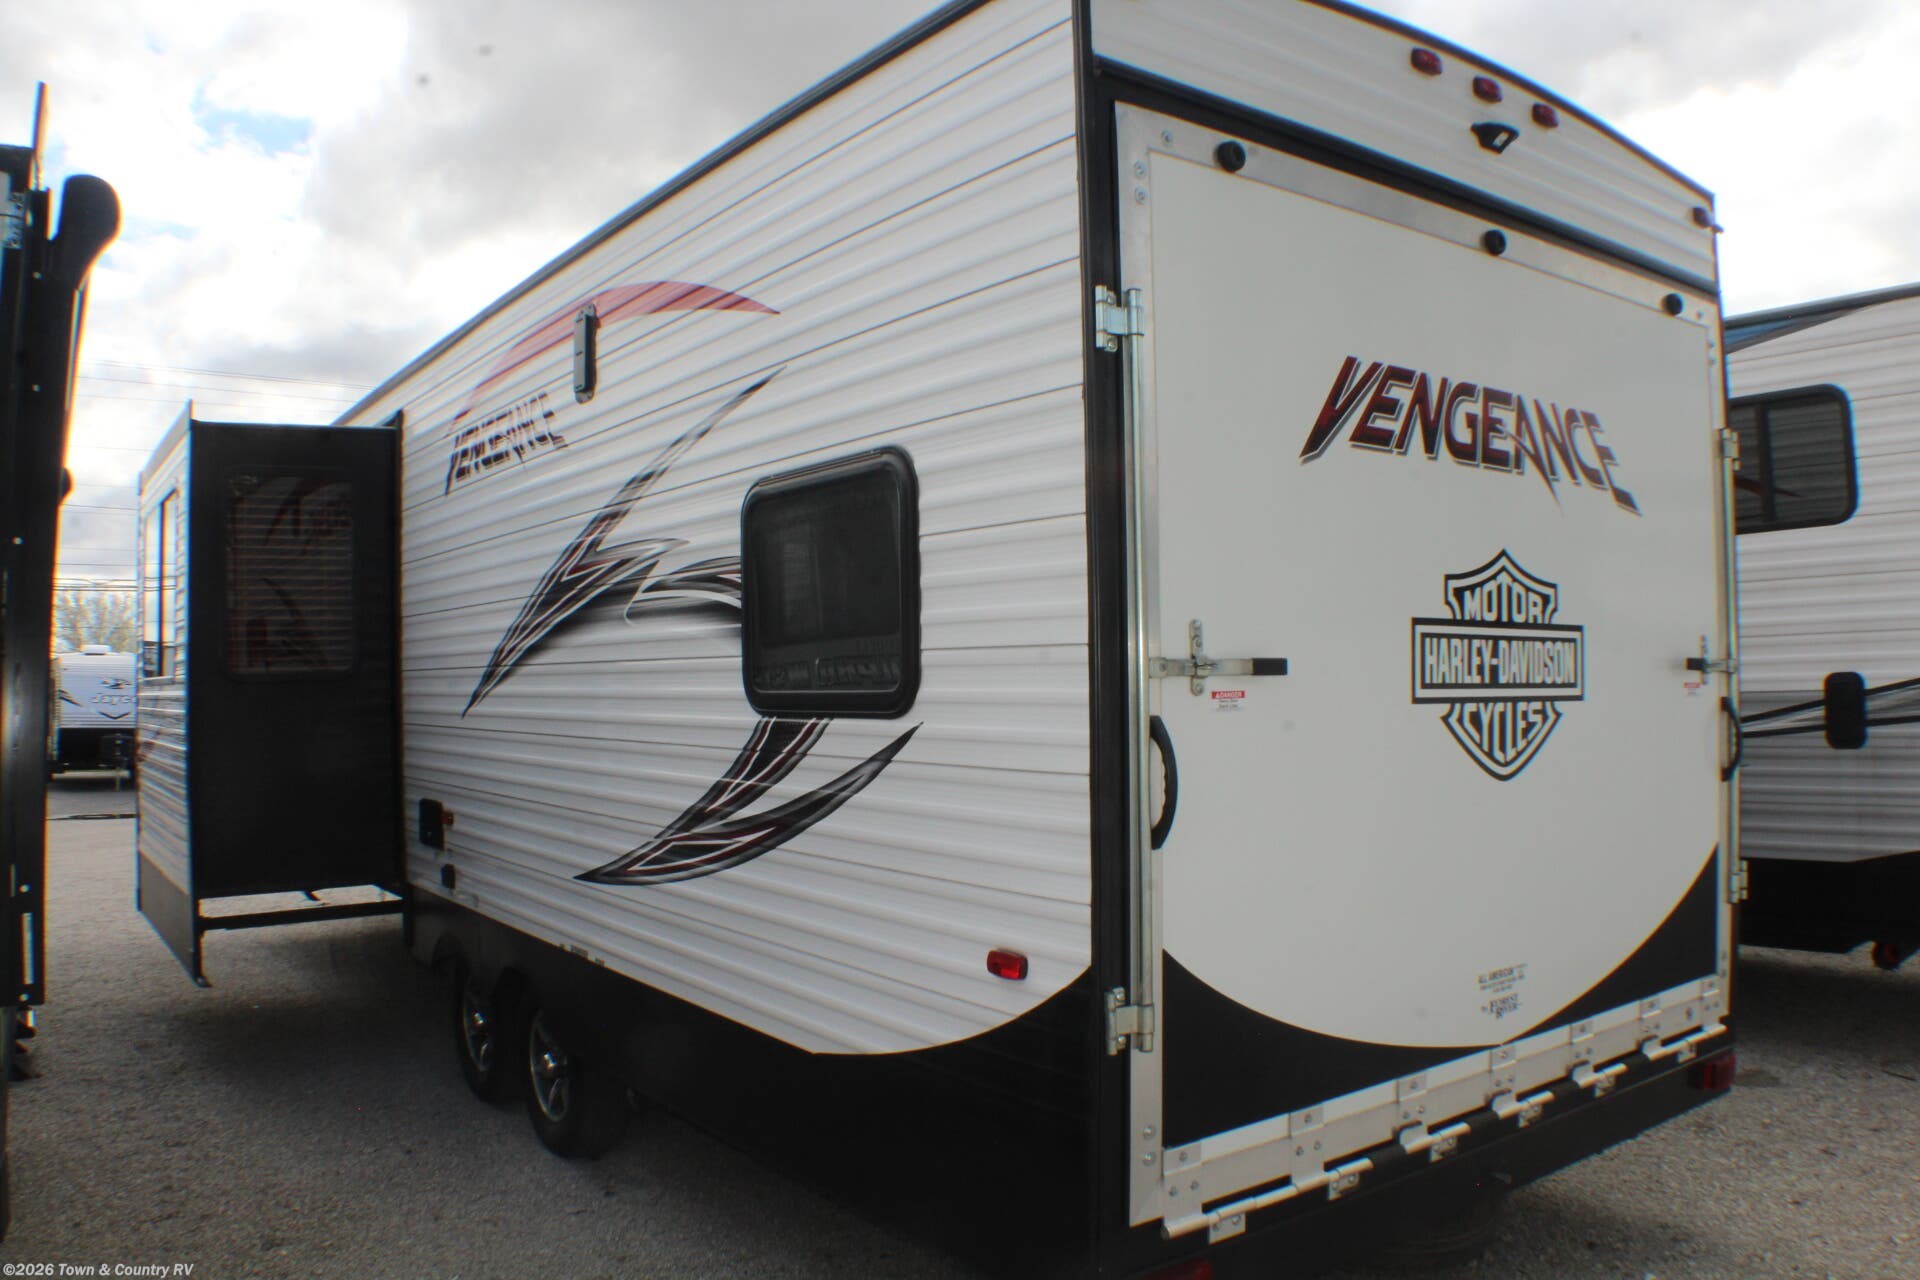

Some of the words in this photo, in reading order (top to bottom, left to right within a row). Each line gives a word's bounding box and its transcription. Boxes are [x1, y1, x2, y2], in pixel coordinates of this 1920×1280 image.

[445, 392, 568, 495] VENGEANCE
[1299, 355, 1642, 519] VENGEANCE
[1462, 570, 1543, 624] MOTOR
[1424, 636, 1576, 685] HARLEY-DAVIDSON
[1462, 701, 1543, 764] CYCLES
